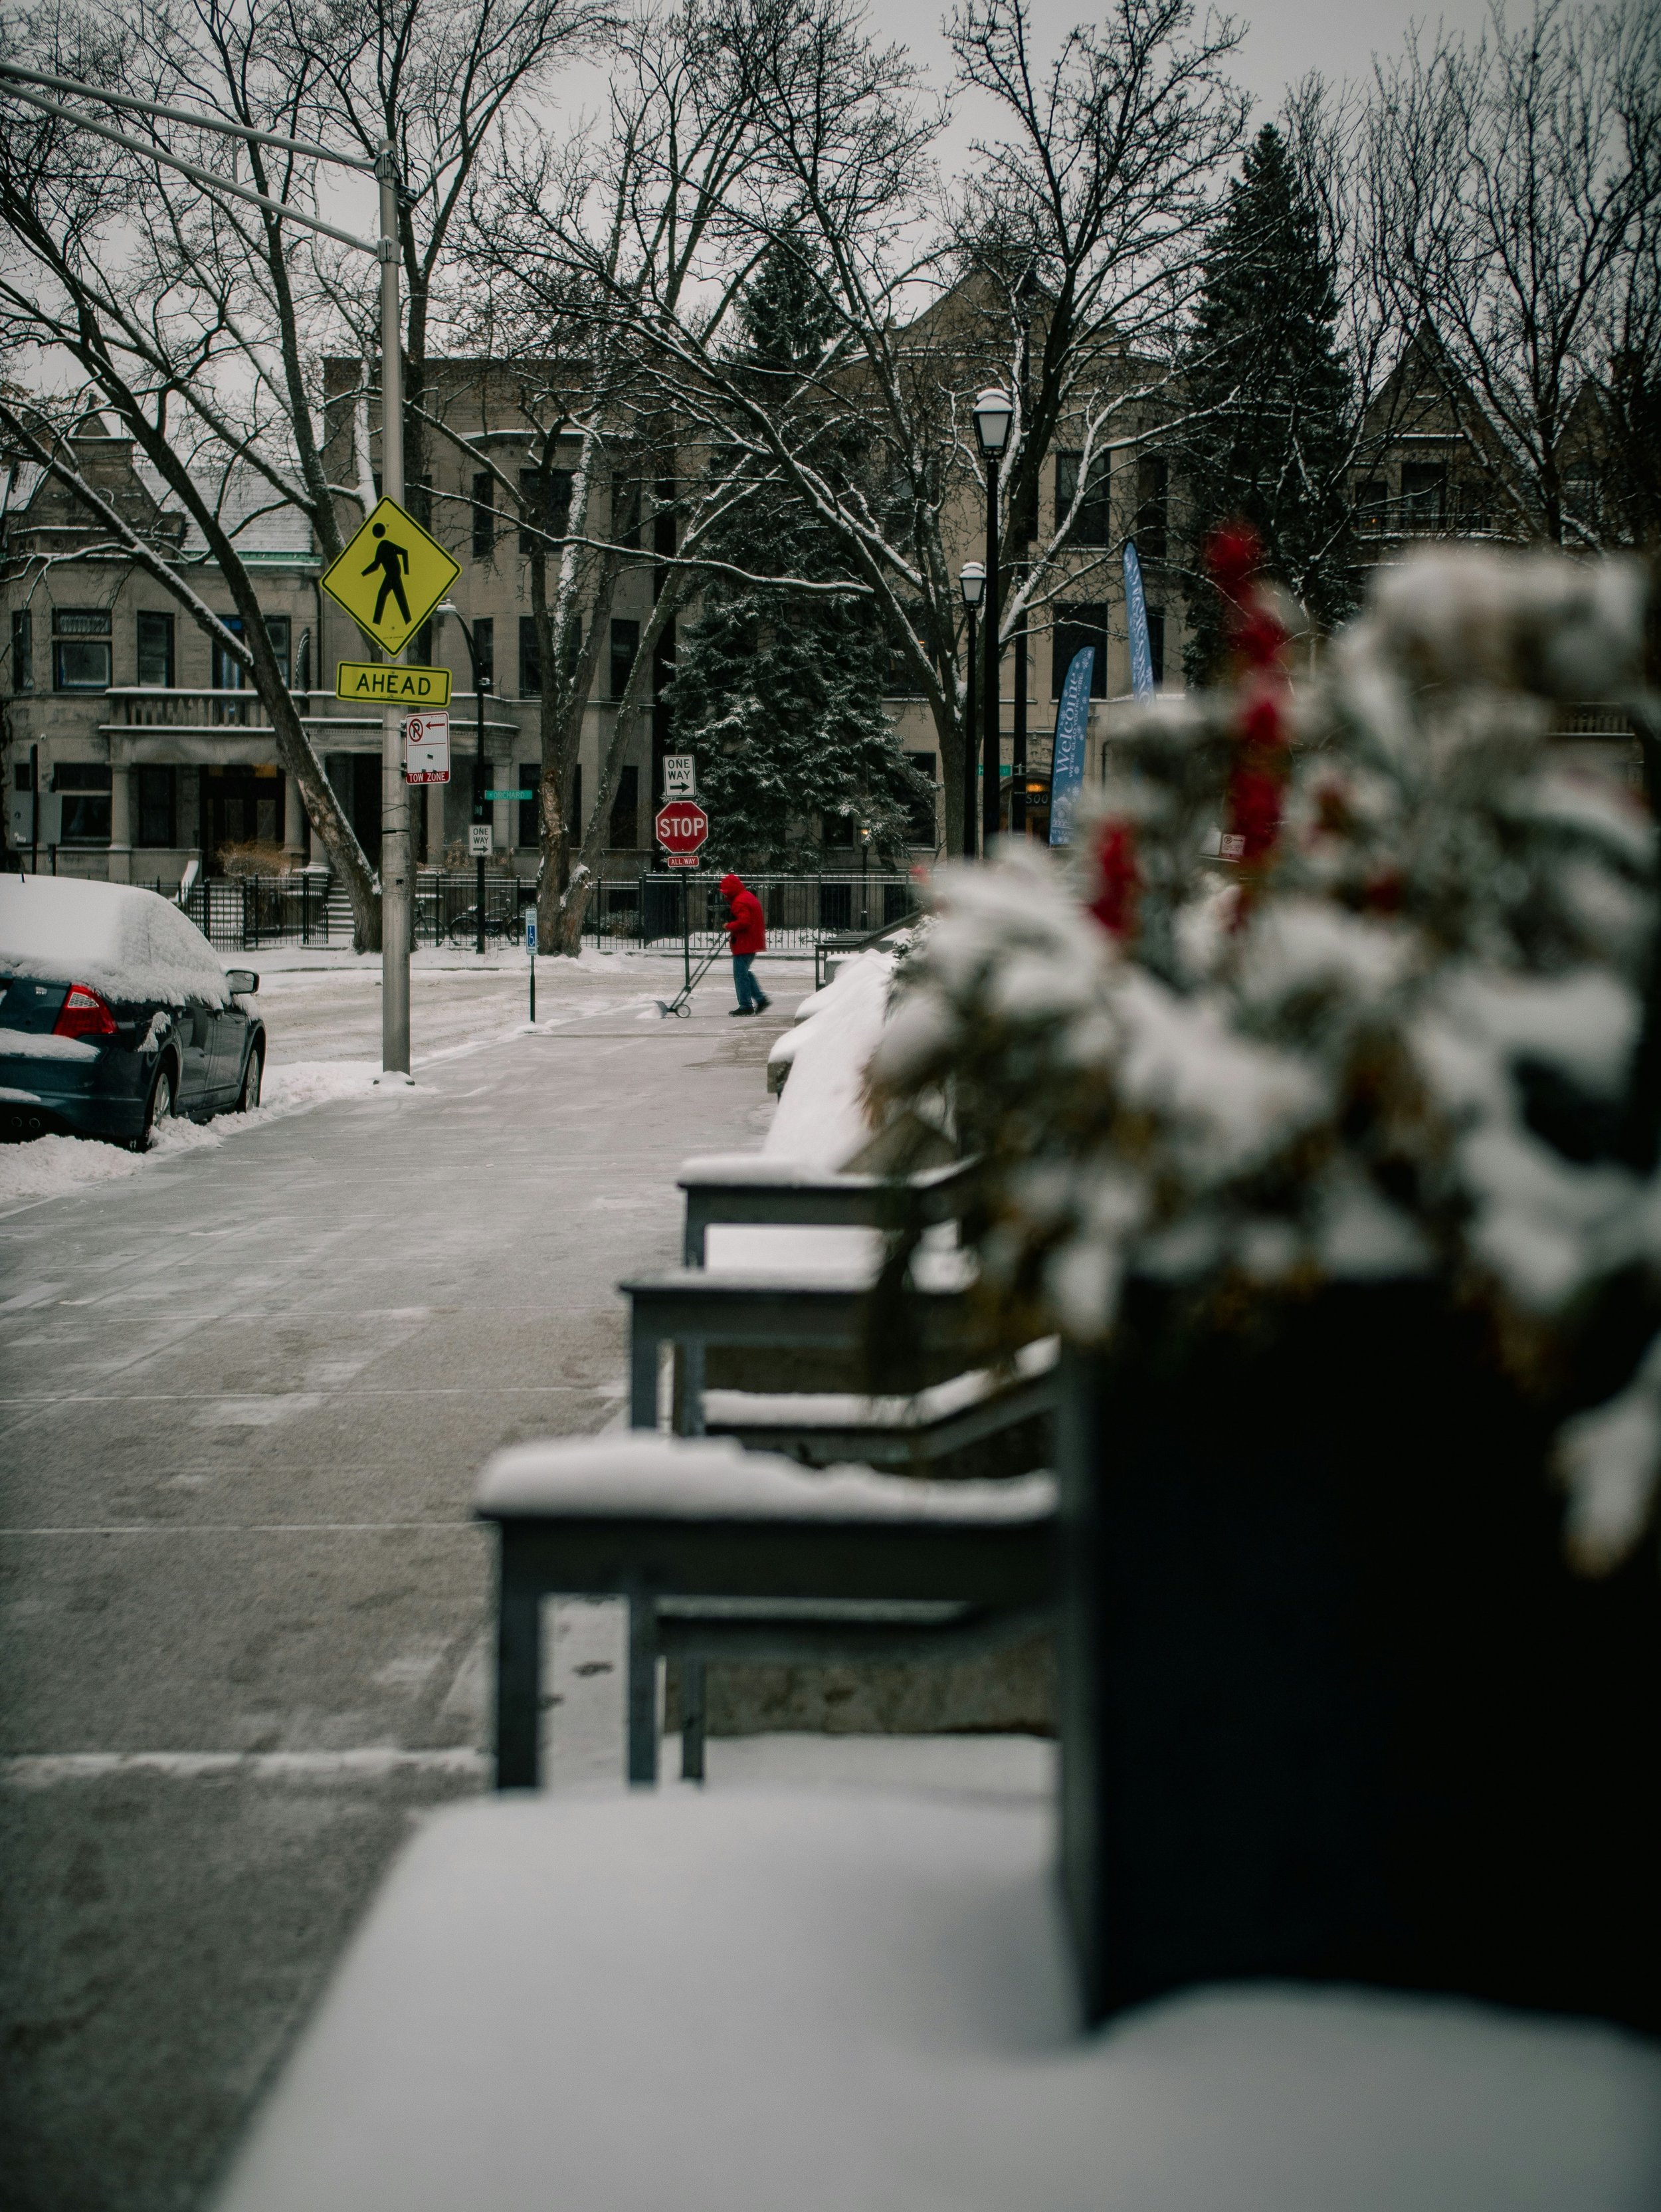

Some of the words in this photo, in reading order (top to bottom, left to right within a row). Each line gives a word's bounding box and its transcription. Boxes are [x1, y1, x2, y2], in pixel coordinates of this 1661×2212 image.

[356, 673, 431, 696] AHEAD
[1056, 672, 1078, 773] Welcome
[668, 759, 690, 769] ONE
[409, 773, 423, 782] TOW
[427, 772, 446, 781] ZONE
[668, 770, 691, 780] WAY
[1025, 794, 1048, 804] 500
[660, 817, 704, 838] STOP
